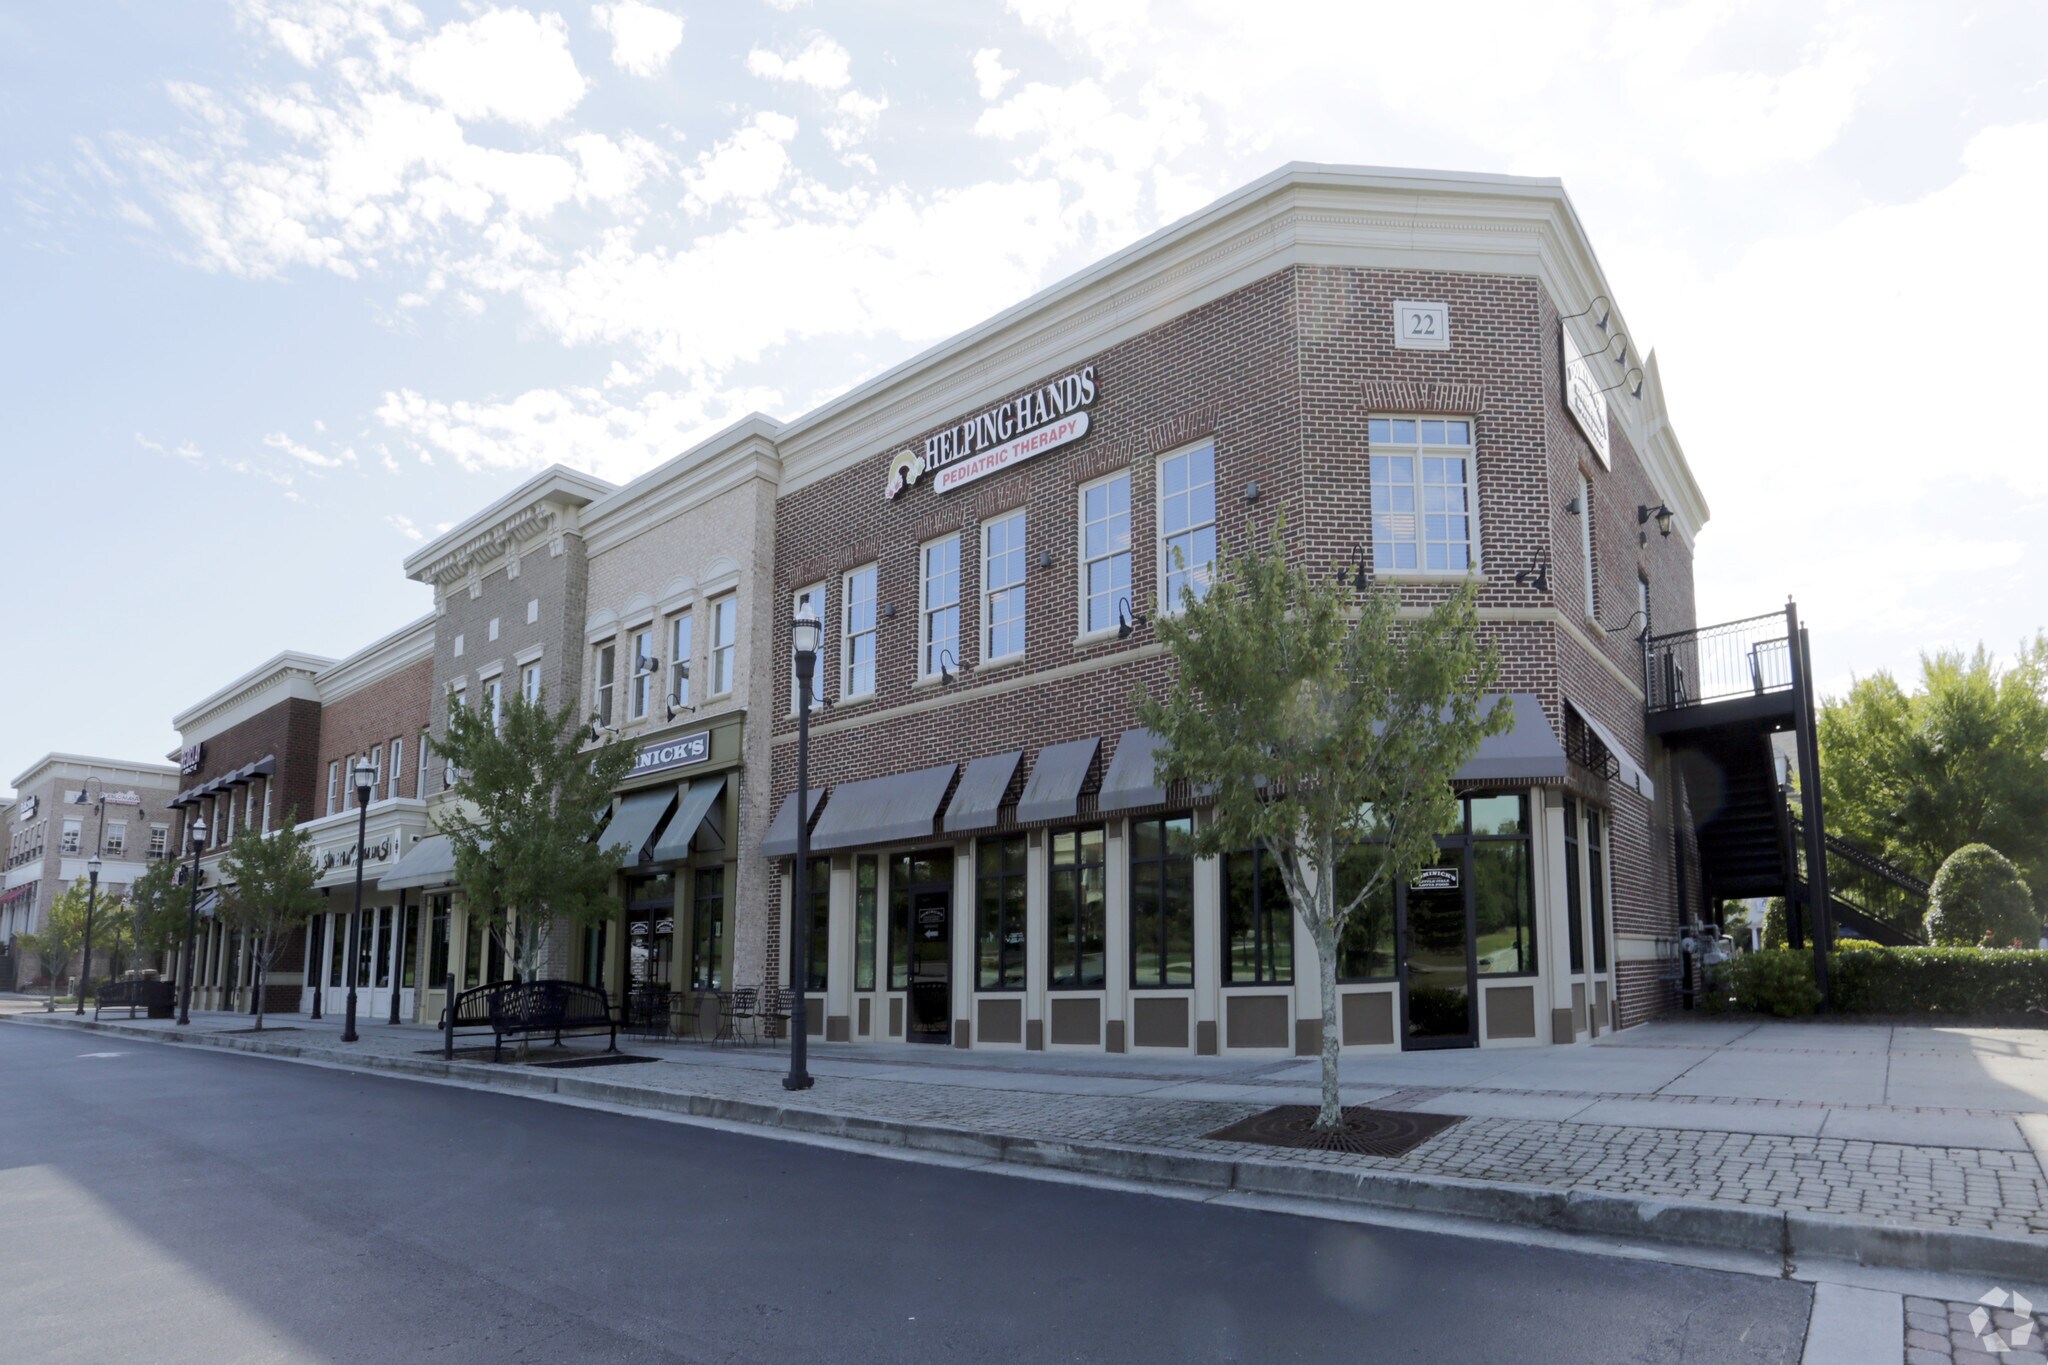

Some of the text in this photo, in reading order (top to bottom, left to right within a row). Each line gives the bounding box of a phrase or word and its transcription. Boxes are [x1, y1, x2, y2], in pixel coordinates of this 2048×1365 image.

[1411, 314, 1435, 335] 22
[925, 366, 1095, 472] HELPING HANDS
[942, 419, 1077, 486] PEDIATRIC THERAPY
[633, 739, 705, 769] INICK'S
